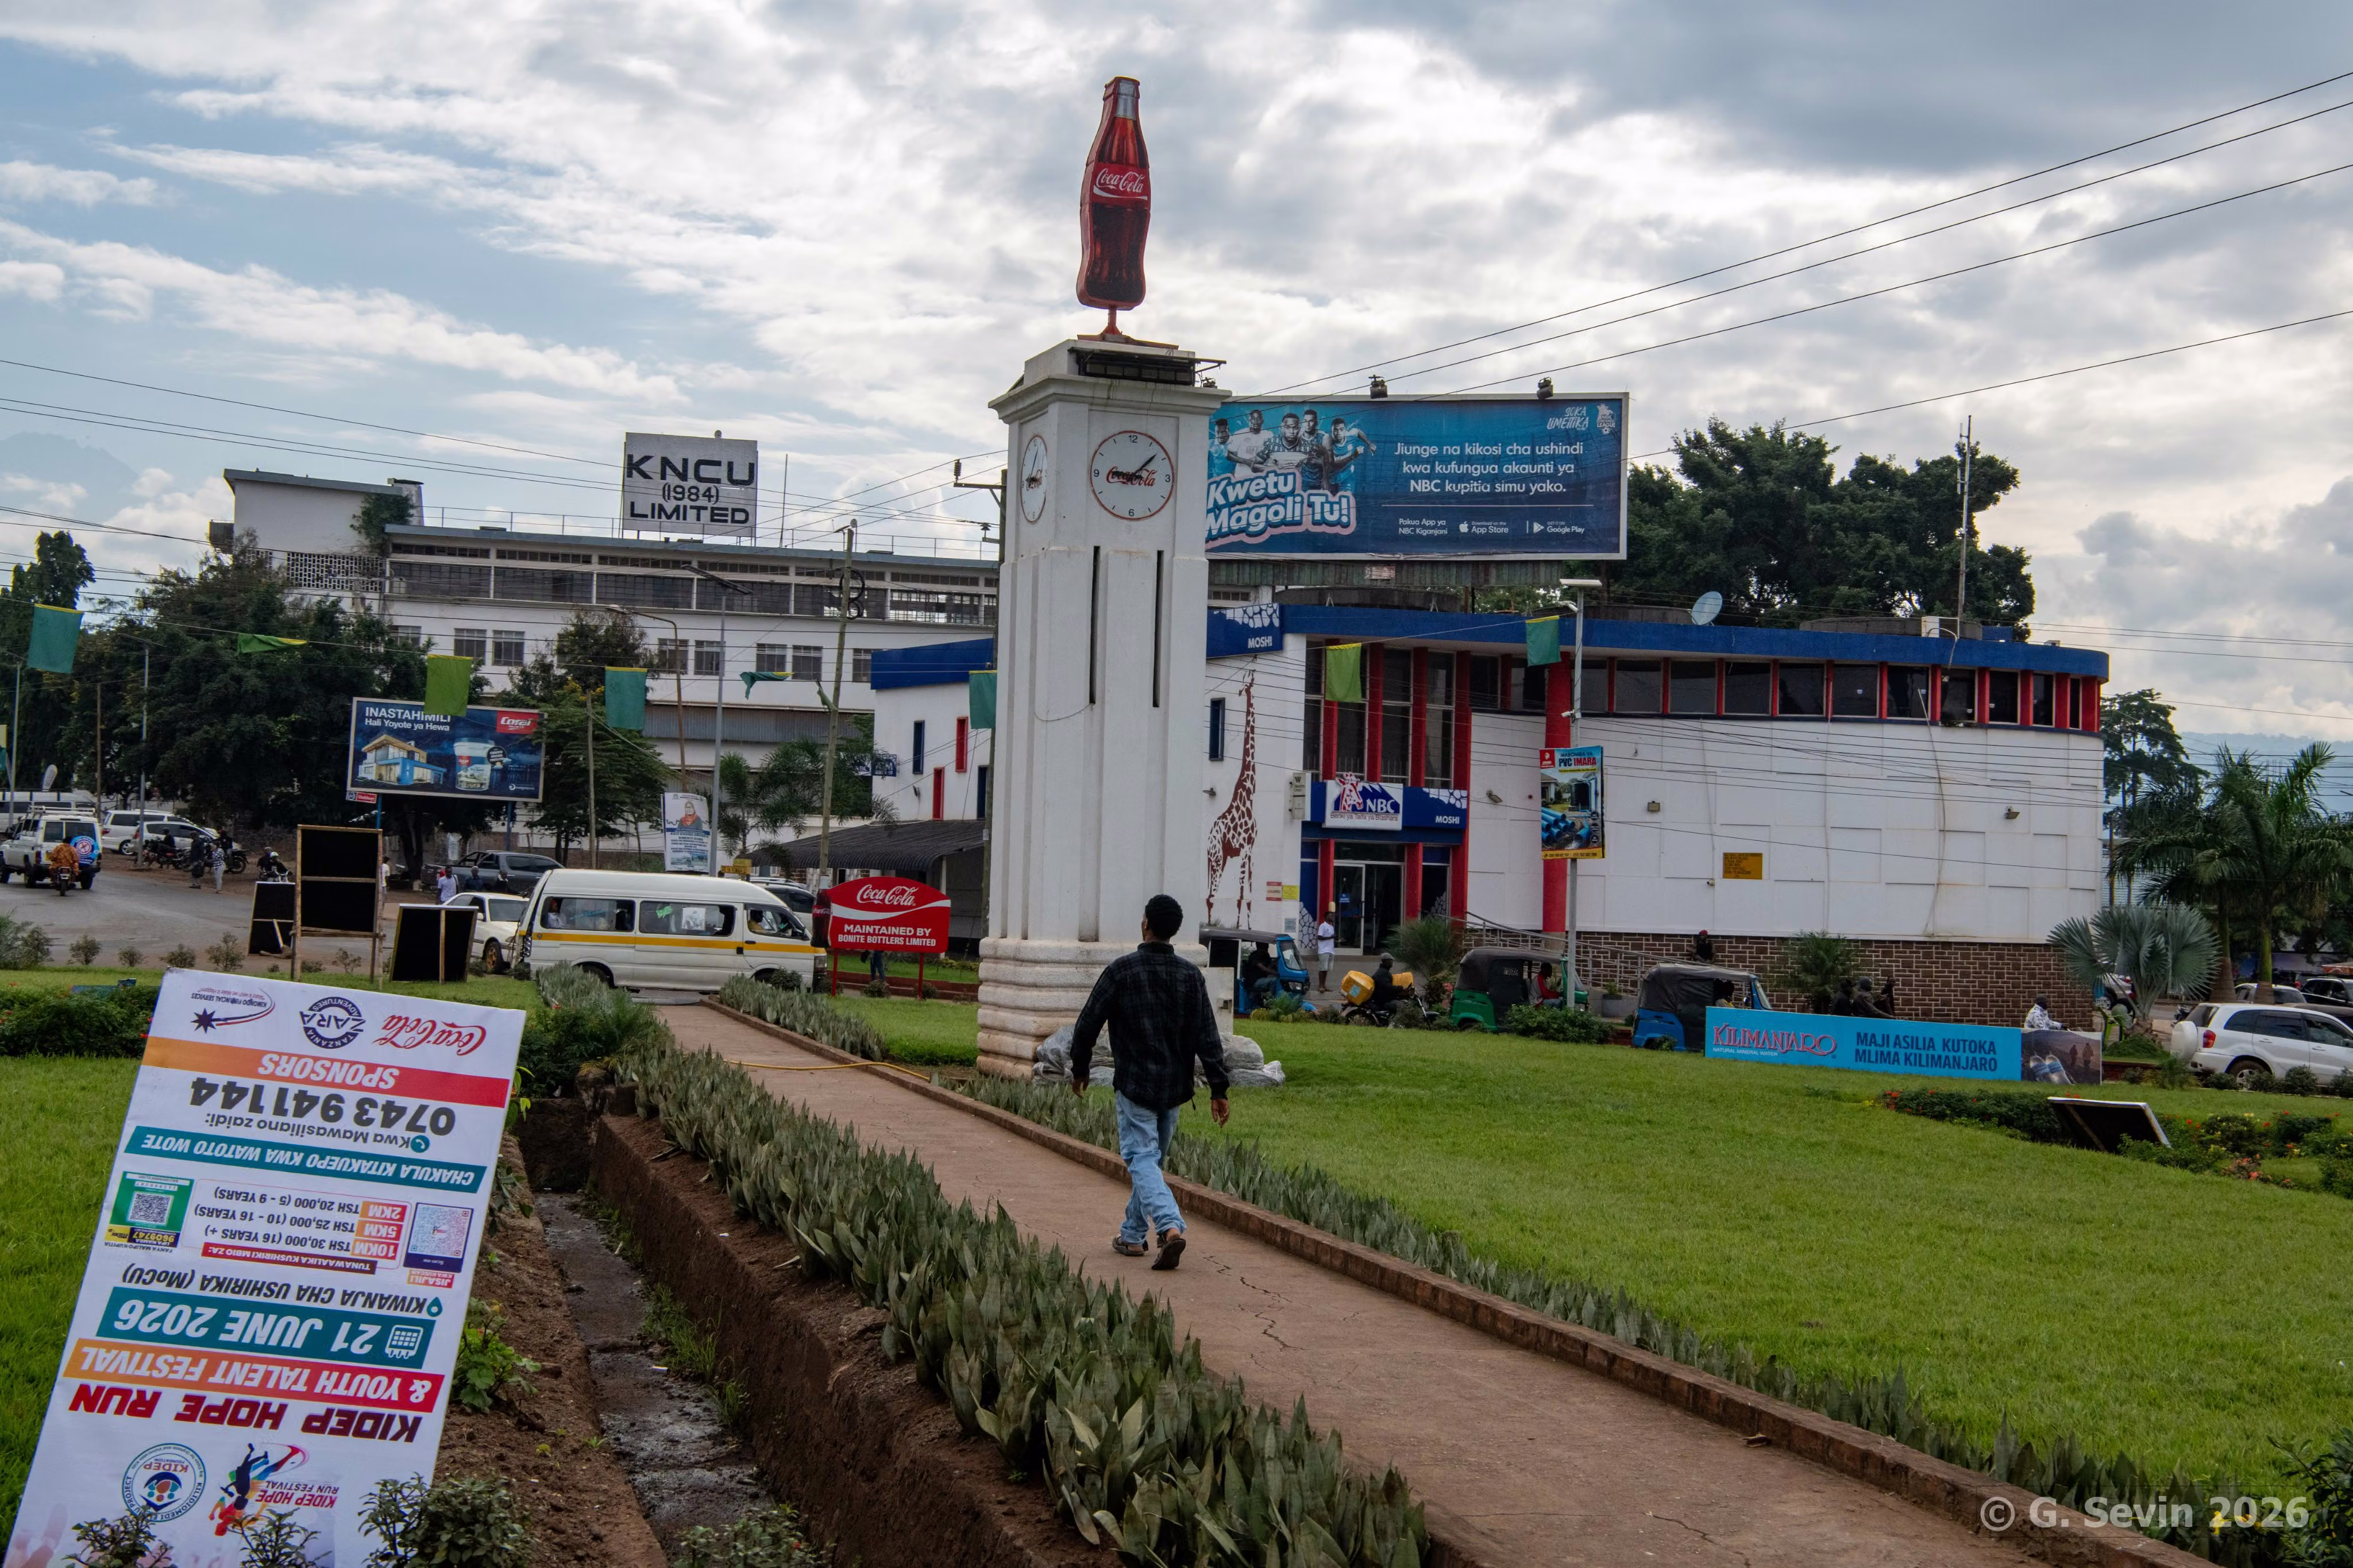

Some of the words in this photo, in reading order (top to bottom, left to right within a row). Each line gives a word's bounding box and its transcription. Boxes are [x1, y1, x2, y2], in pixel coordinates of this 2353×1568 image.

[1096, 168, 1144, 193] Coca-Cola
[1128, 435, 1138, 443] 12
[1394, 443, 1438, 458] Jiunge
[1442, 445, 1460, 455] na
[1465, 442, 1502, 455] kikosi
[1506, 443, 1531, 455] cha
[1536, 442, 1583, 455] ushindi
[626, 454, 755, 486] KNCU
[1093, 469, 1100, 477] 9
[1403, 461, 1430, 473] kwa
[1435, 461, 1498, 476] kufungua
[1503, 461, 1554, 474] akaunti
[1557, 464, 1574, 476] ya
[1165, 474, 1171, 482] 3
[662, 482, 719, 505] (1984)
[1207, 472, 1294, 509] Kwetu
[1410, 480, 1441, 492] NBC
[1445, 480, 1490, 495] kupitia
[1495, 480, 1525, 492] simu
[1529, 480, 1567, 495] yako.
[630, 501, 750, 524] LIMITED
[1128, 509, 1135, 517] 6
[1205, 496, 1302, 535] Magoli
[1309, 495, 1348, 523] Tu!
[1421, 518, 1436, 527] App
[1471, 526, 1488, 534] App
[1546, 526, 1571, 534] Google
[1571, 526, 1585, 534] Play
[1416, 528, 1448, 536] Kiganjani
[365, 706, 451, 723] INASTAHIMILI
[365, 718, 382, 727] Hali
[383, 719, 412, 729] Yoyote
[425, 723, 450, 731] Hewa
[1559, 758, 1572, 767] PVC
[1573, 756, 1596, 766] IMARA
[1366, 798, 1395, 813] NBC
[1436, 815, 1460, 824] MOSHI
[844, 924, 915, 936] MAINTAINED
[916, 928, 932, 936] BY
[838, 934, 865, 943] BONITE
[867, 936, 904, 945] BOTTLERS
[906, 937, 936, 947] LIMITED
[191, 992, 215, 1002] SERVICES
[215, 996, 242, 1005] FINNCIAL
[313, 998, 360, 1017] ADVENTURES
[299, 1011, 366, 1033] ZARA
[307, 1029, 354, 1048] TANZANIA
[372, 1014, 487, 1056] Coca-Cola
[1713, 1023, 1837, 1056] KILIMANJARO
[1856, 1032, 1890, 1048] MAJI
[1893, 1034, 1936, 1052] ASILIA
[1942, 1038, 1997, 1055] KUTOKA
[1855, 1048, 1900, 1065] MLIMA
[1904, 1052, 1998, 1072] KILIMANJARO
[257, 1053, 400, 1090] SPONSORS
[190, 1077, 345, 1123] 941144
[205, 1113, 253, 1129] zaidi:
[353, 1097, 456, 1137] 0743
[257, 1119, 369, 1144] Mawasiliano
[141, 1134, 191, 1153] WOTE
[374, 1133, 411, 1149] Kwa
[194, 1141, 262, 1161] WATOTO
[265, 1150, 304, 1166] KWA
[306, 1153, 397, 1177] KITAKUEPO
[400, 1164, 475, 1185] CHAKULA
[214, 1186, 256, 1203] YEARS)
[260, 1194, 267, 1203] 9
[279, 1194, 291, 1206] (5
[194, 1203, 236, 1221] YEARS)
[294, 1198, 334, 1211] 20,000
[338, 1202, 359, 1214] TSH
[368, 1204, 401, 1220] 2KM
[240, 1211, 254, 1222] 16
[267, 1213, 287, 1226] (10
[290, 1216, 329, 1230] 25,000
[205, 1225, 218, 1237] +)
[333, 1221, 355, 1233] TSH
[363, 1223, 399, 1238] 5KM
[133, 1231, 175, 1243] 9609747
[221, 1229, 259, 1242] YEARS
[262, 1233, 282, 1245] (16
[285, 1235, 326, 1250] 30,000
[208, 1247, 225, 1255] ZA:
[226, 1248, 250, 1258] MBIO
[329, 1240, 351, 1253] TSH
[354, 1241, 396, 1258] 10KM
[251, 1250, 299, 1264] KUSHIRIKI
[300, 1255, 371, 1270] TUNAWAALIKA
[122, 1263, 195, 1289] (MoCU)
[199, 1275, 292, 1300] USHIRIKA
[295, 1283, 334, 1305] CHA
[341, 1289, 428, 1314] KIWANJA
[114, 1299, 211, 1338] 2026
[218, 1310, 324, 1349] JUNE
[331, 1321, 382, 1355] 21
[80, 1346, 208, 1381] FESTIVAL
[209, 1360, 312, 1392] TALENT
[314, 1370, 401, 1401] YOUTH
[408, 1380, 433, 1403] &
[68, 1383, 163, 1418] RUN
[174, 1393, 289, 1430] HOPE
[302, 1407, 422, 1443] KIDEP
[142, 1462, 189, 1473] KIDEP
[125, 1476, 135, 1508] PROJECT
[265, 1480, 315, 1492] FESTIVAL
[317, 1485, 340, 1494] RUN
[255, 1489, 294, 1505] HOPE
[295, 1493, 338, 1508] KIDEP
